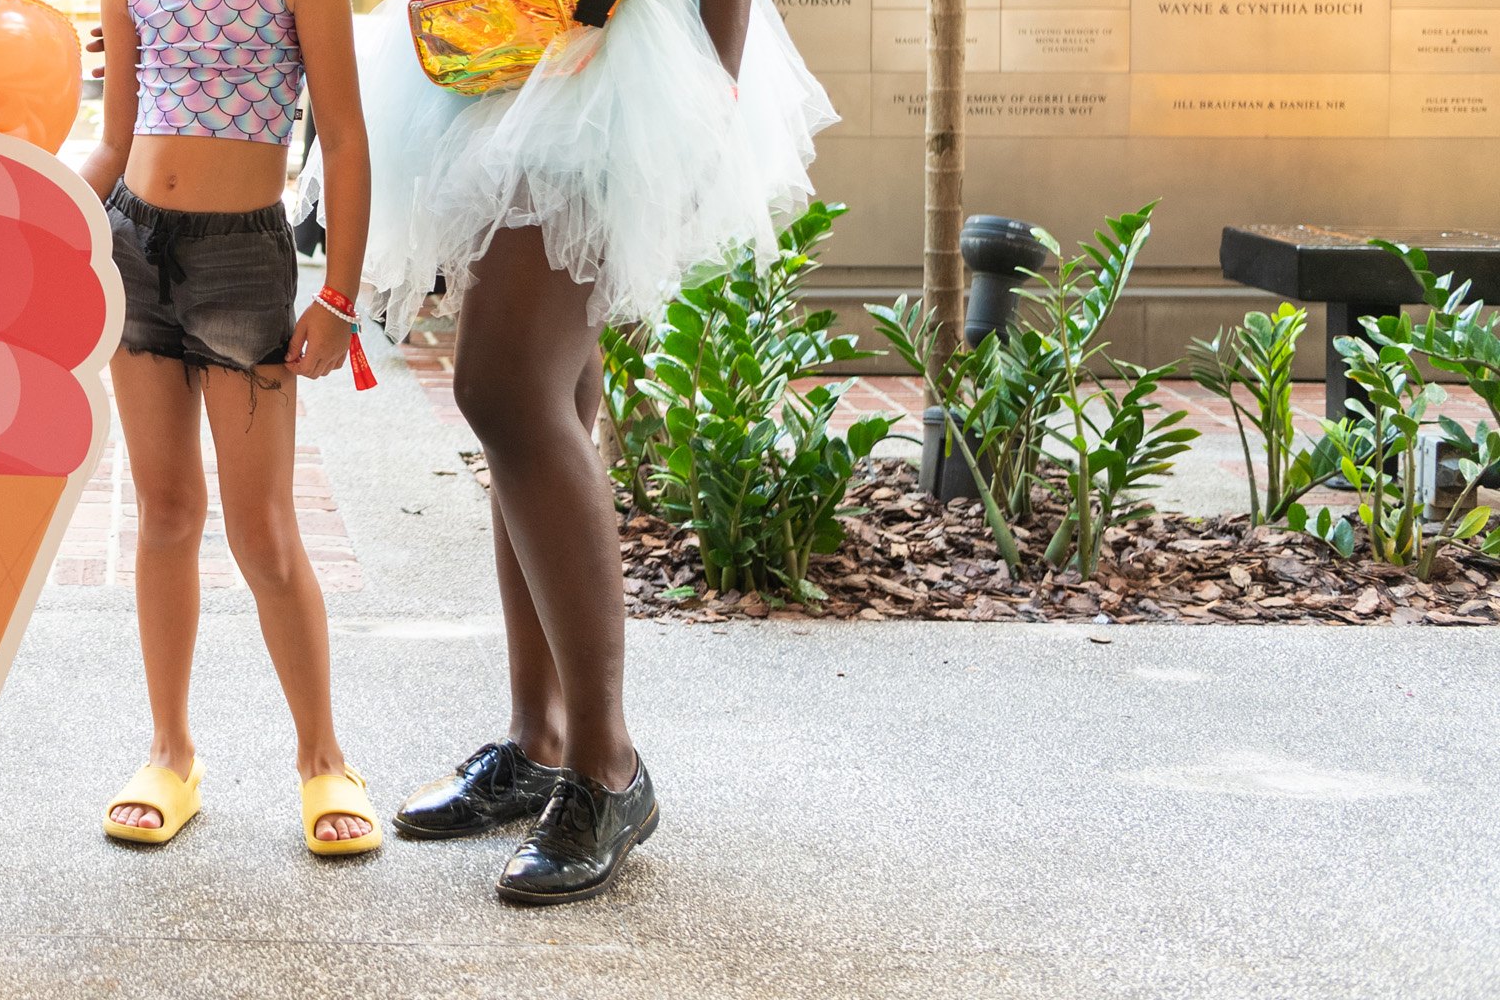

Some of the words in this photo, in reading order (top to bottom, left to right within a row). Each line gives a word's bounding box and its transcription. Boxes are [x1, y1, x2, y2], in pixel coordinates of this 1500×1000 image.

[1158, 3, 1213, 15] WAYNE
[1219, 3, 1229, 15] &
[1236, 3, 1308, 15] CYNTHIA
[1314, 3, 1363, 15] BOICH
[1064, 28, 1099, 36] MEMORY
[1102, 28, 1113, 36] OF
[893, 94, 905, 103] IN
[966, 94, 1007, 104] EMORY
[1010, 94, 1024, 104] OF
[1172, 101, 1195, 110] JILL
[1199, 101, 1264, 110] BRAUFMAN
[1267, 101, 1275, 110] &
[1279, 101, 1321, 110] DANIEL
[1326, 101, 1347, 110] NIR
[967, 106, 1003, 116] AMILY
[1008, 106, 1065, 116] SUPPORTS
